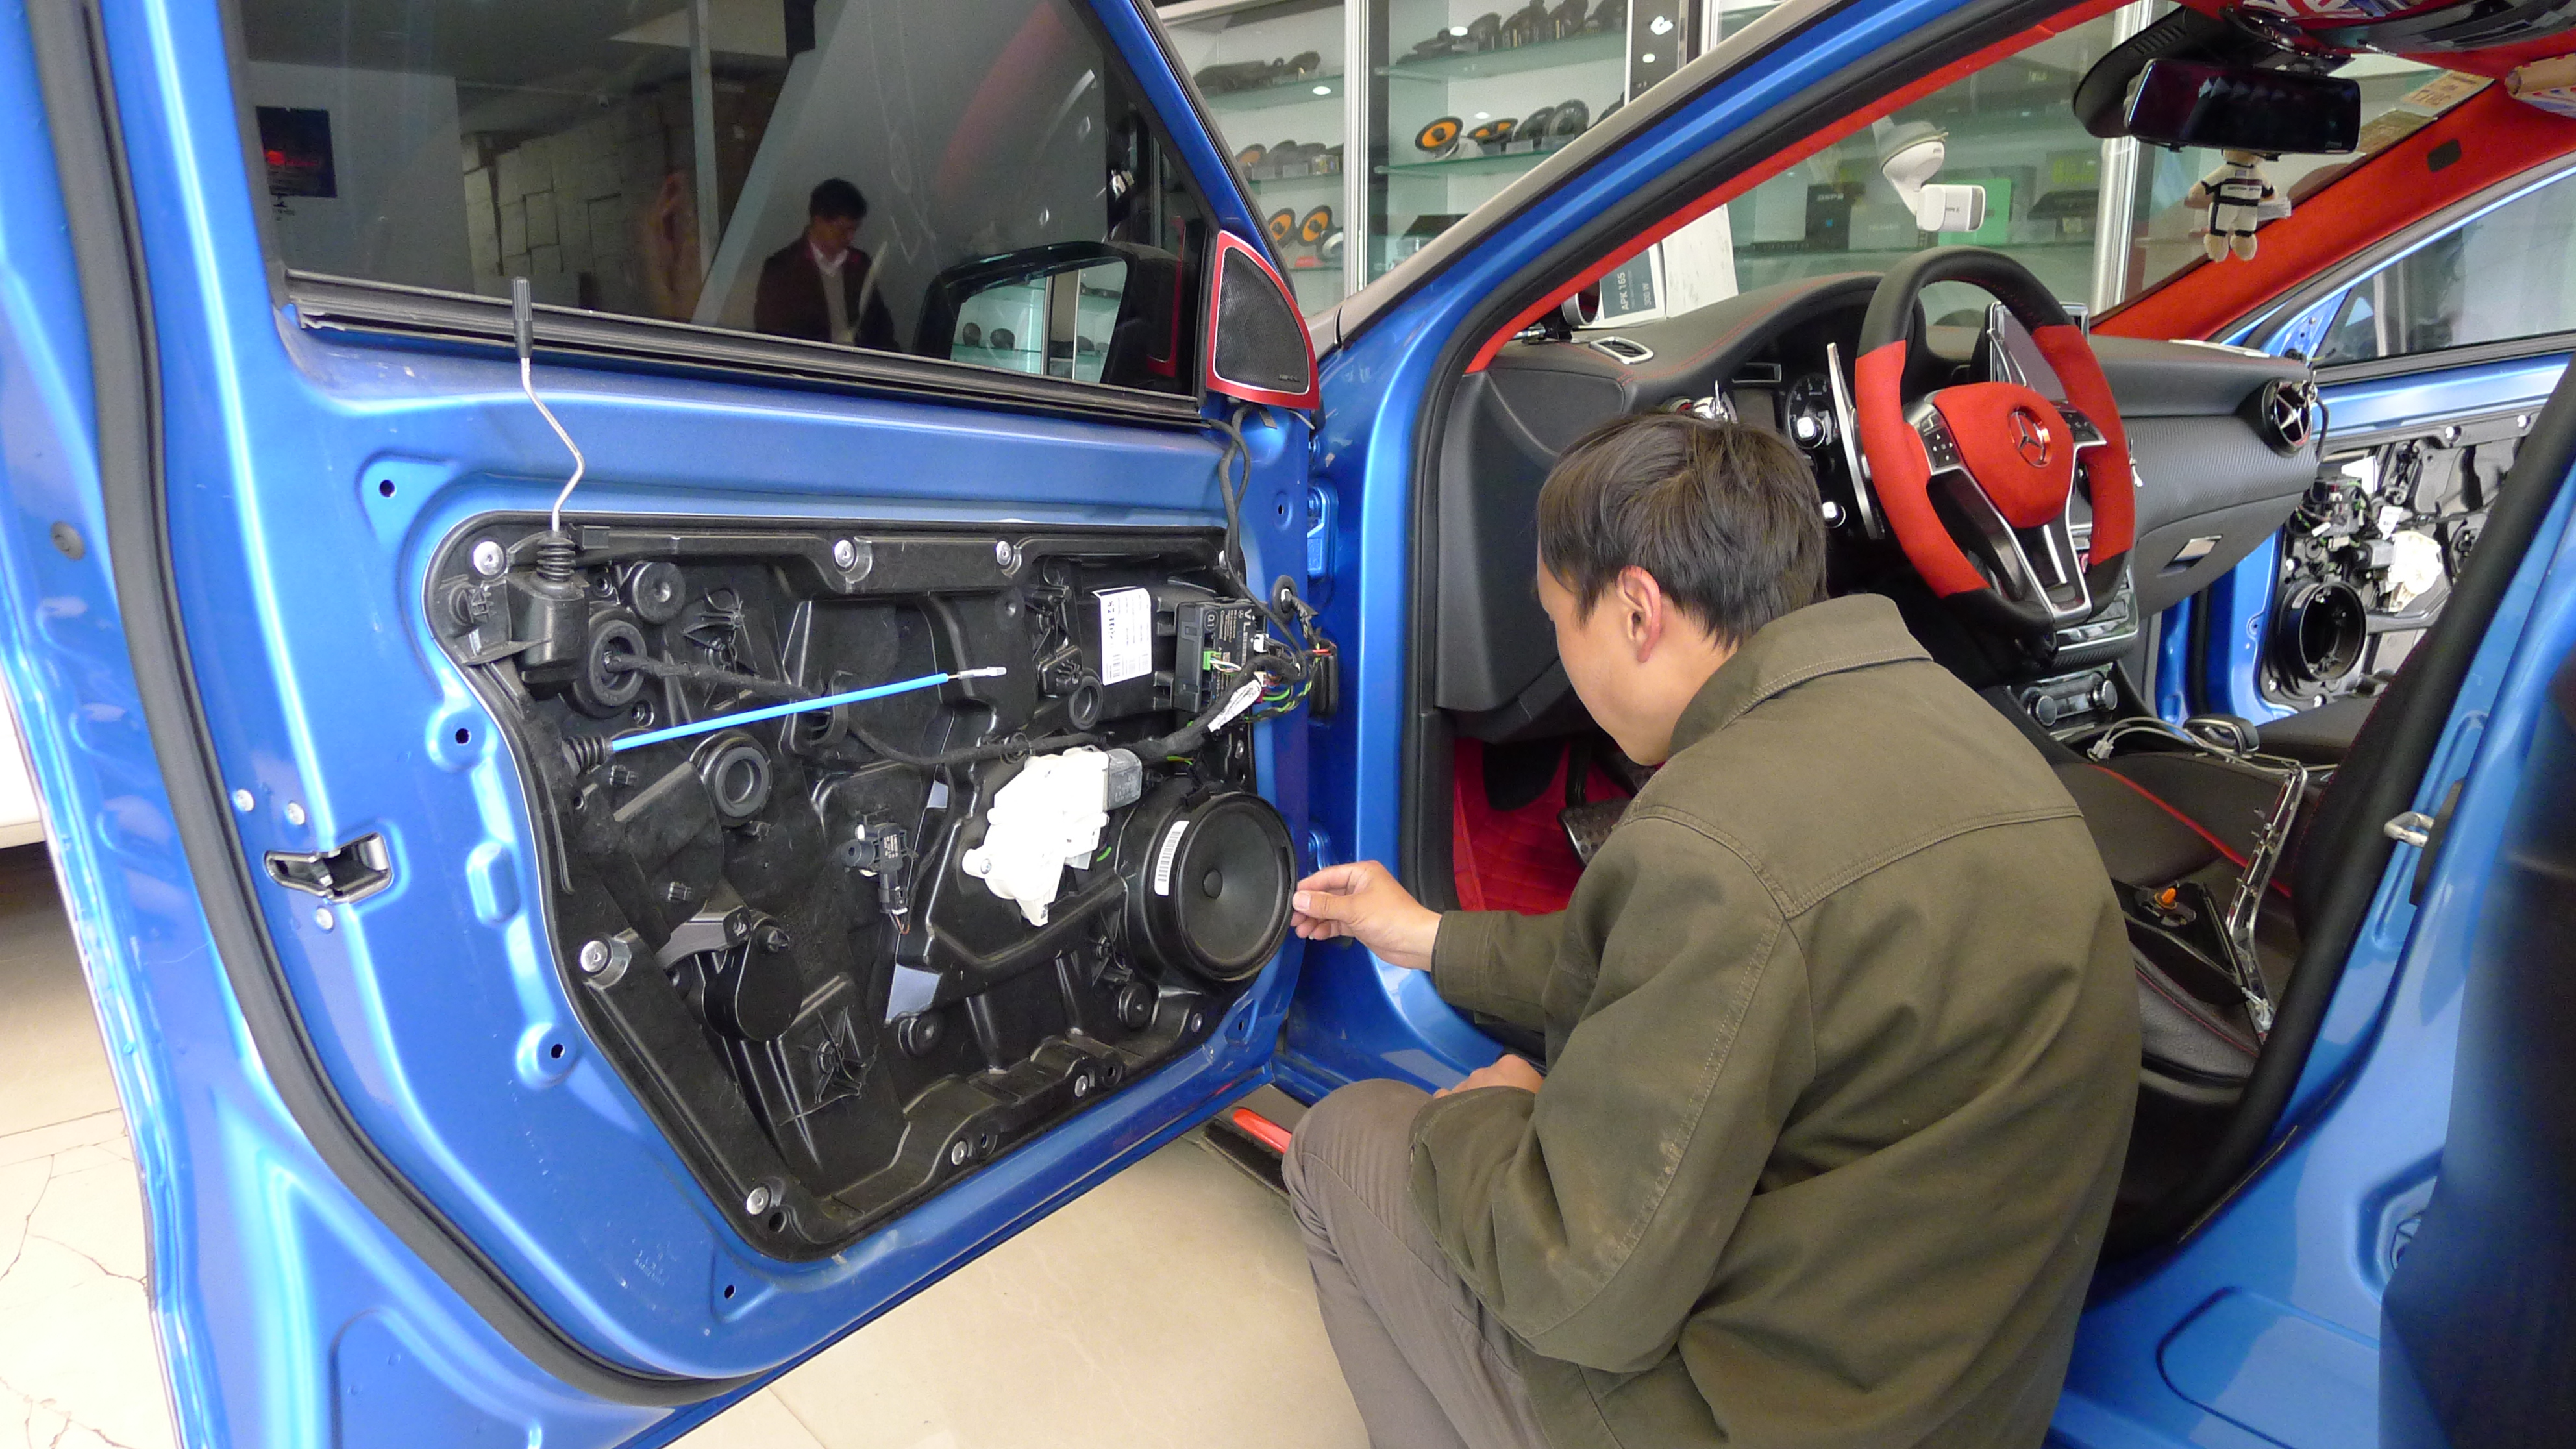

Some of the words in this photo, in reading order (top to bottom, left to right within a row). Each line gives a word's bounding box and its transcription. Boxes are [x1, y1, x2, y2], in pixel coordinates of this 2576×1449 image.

[1617, 272, 1627, 290] 165
[1642, 282, 1649, 291] W
[1619, 291, 1629, 310] APK
[1643, 291, 1652, 306] 300
